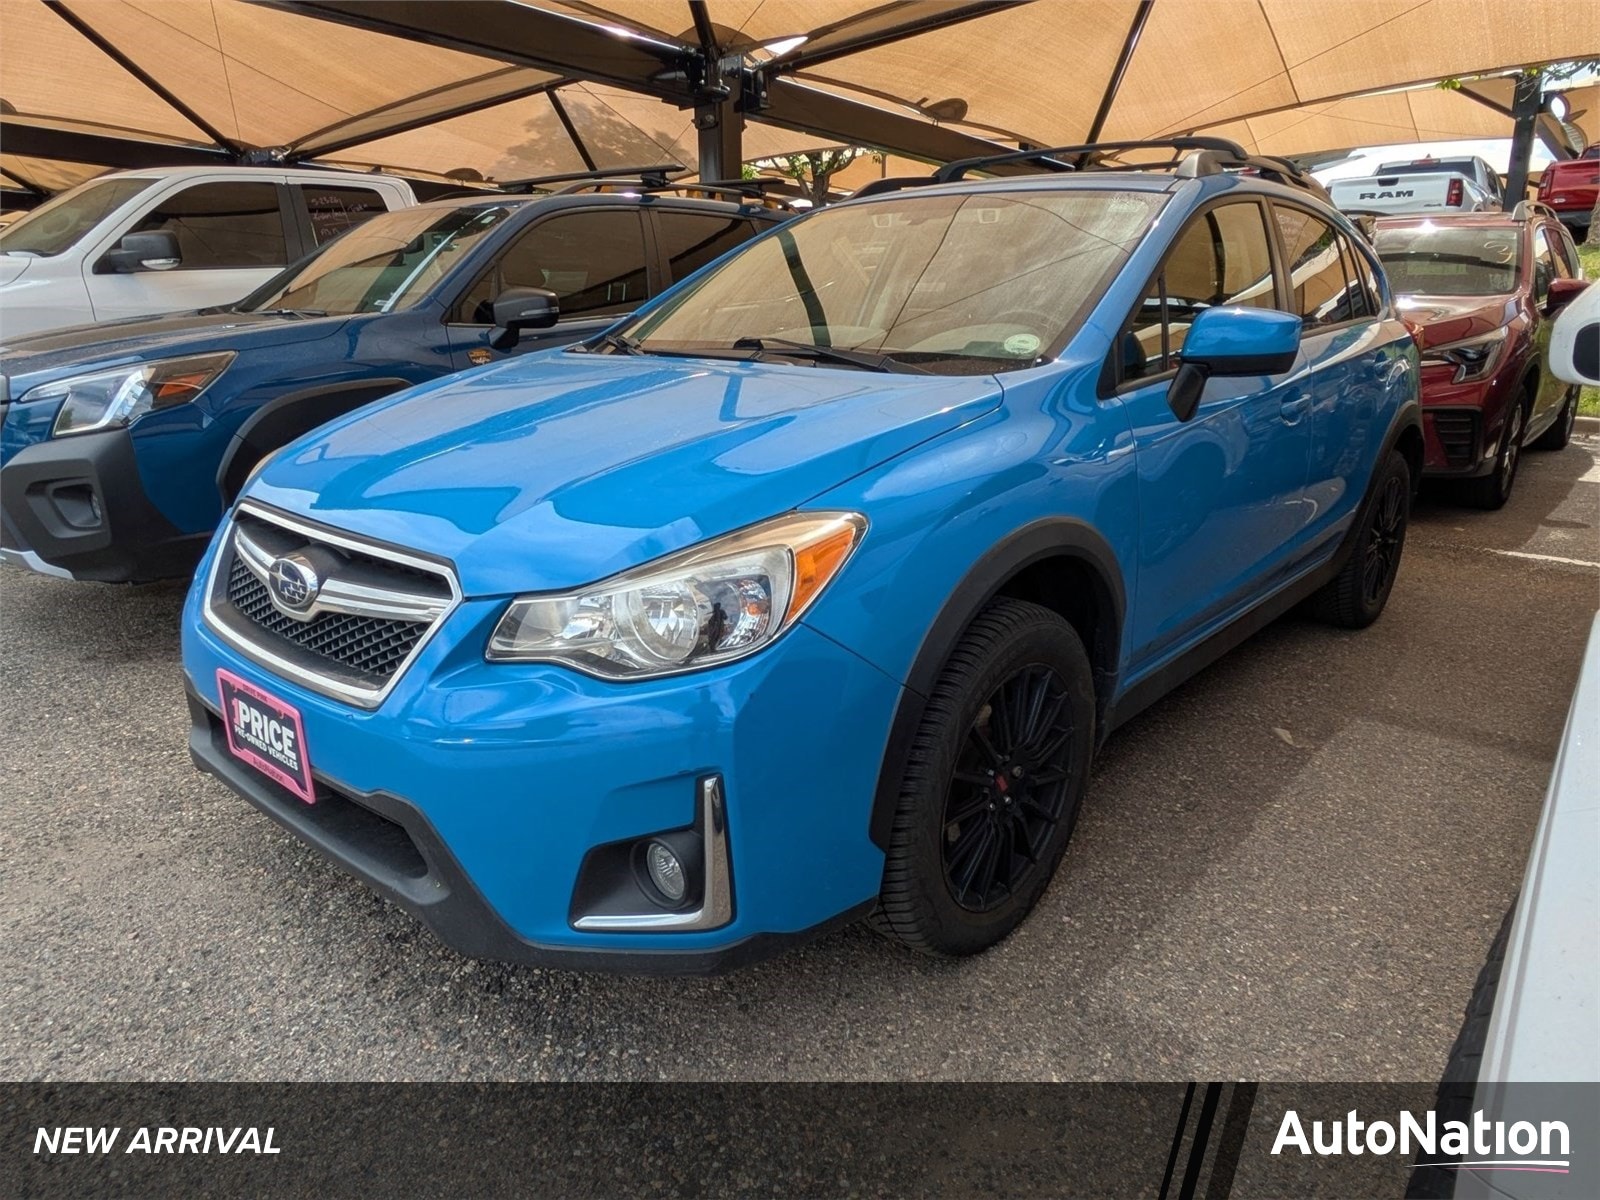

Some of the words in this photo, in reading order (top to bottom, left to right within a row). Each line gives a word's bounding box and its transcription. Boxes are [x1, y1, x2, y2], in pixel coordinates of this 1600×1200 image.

[1359, 190, 1414, 200] RAM
[234, 724, 268, 752] PRE-OWNED
[267, 745, 298, 771] VEHICLES
